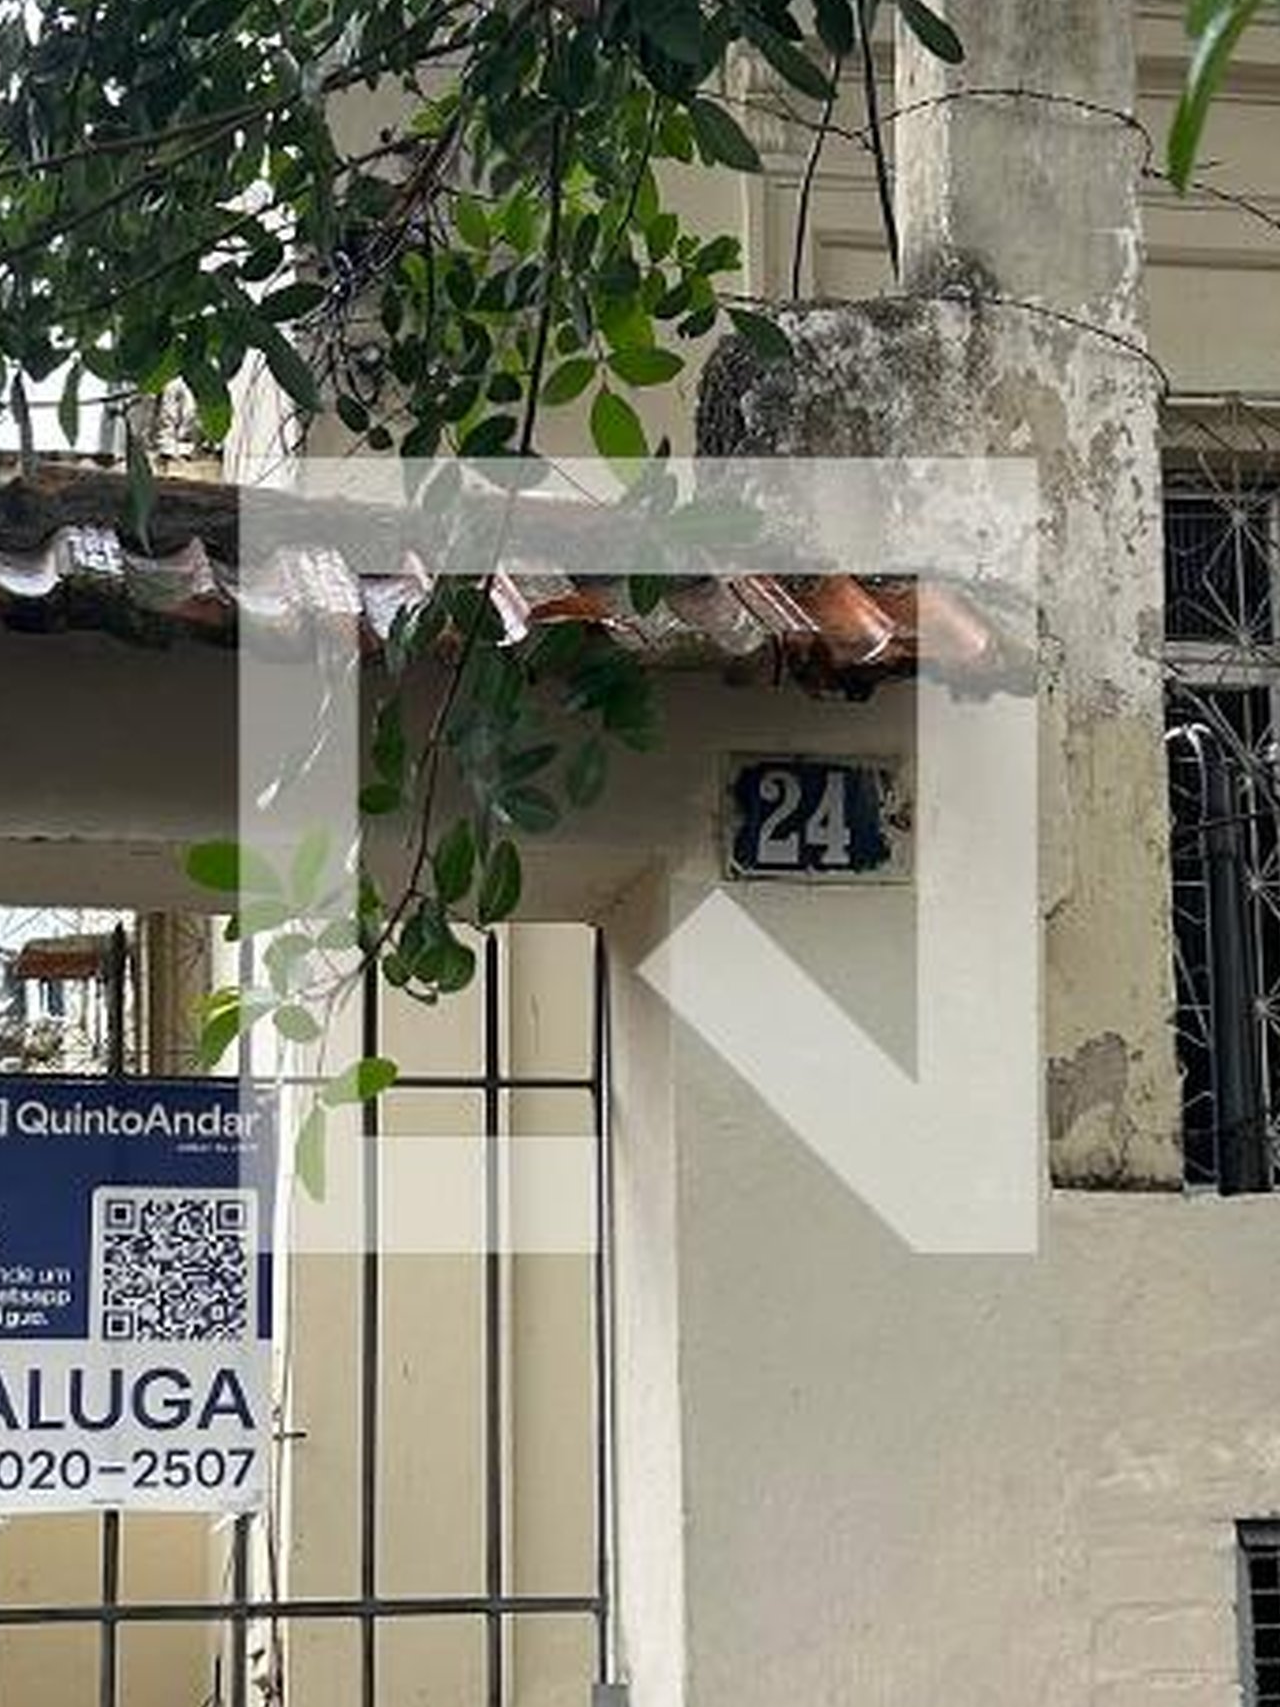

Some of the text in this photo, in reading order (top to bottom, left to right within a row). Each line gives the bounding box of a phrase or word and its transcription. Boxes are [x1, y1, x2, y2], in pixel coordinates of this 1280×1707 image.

[757, 770, 851, 864] 24
[16, 1100, 259, 1137] QuintoAndar
[39, 1267, 71, 1284] um
